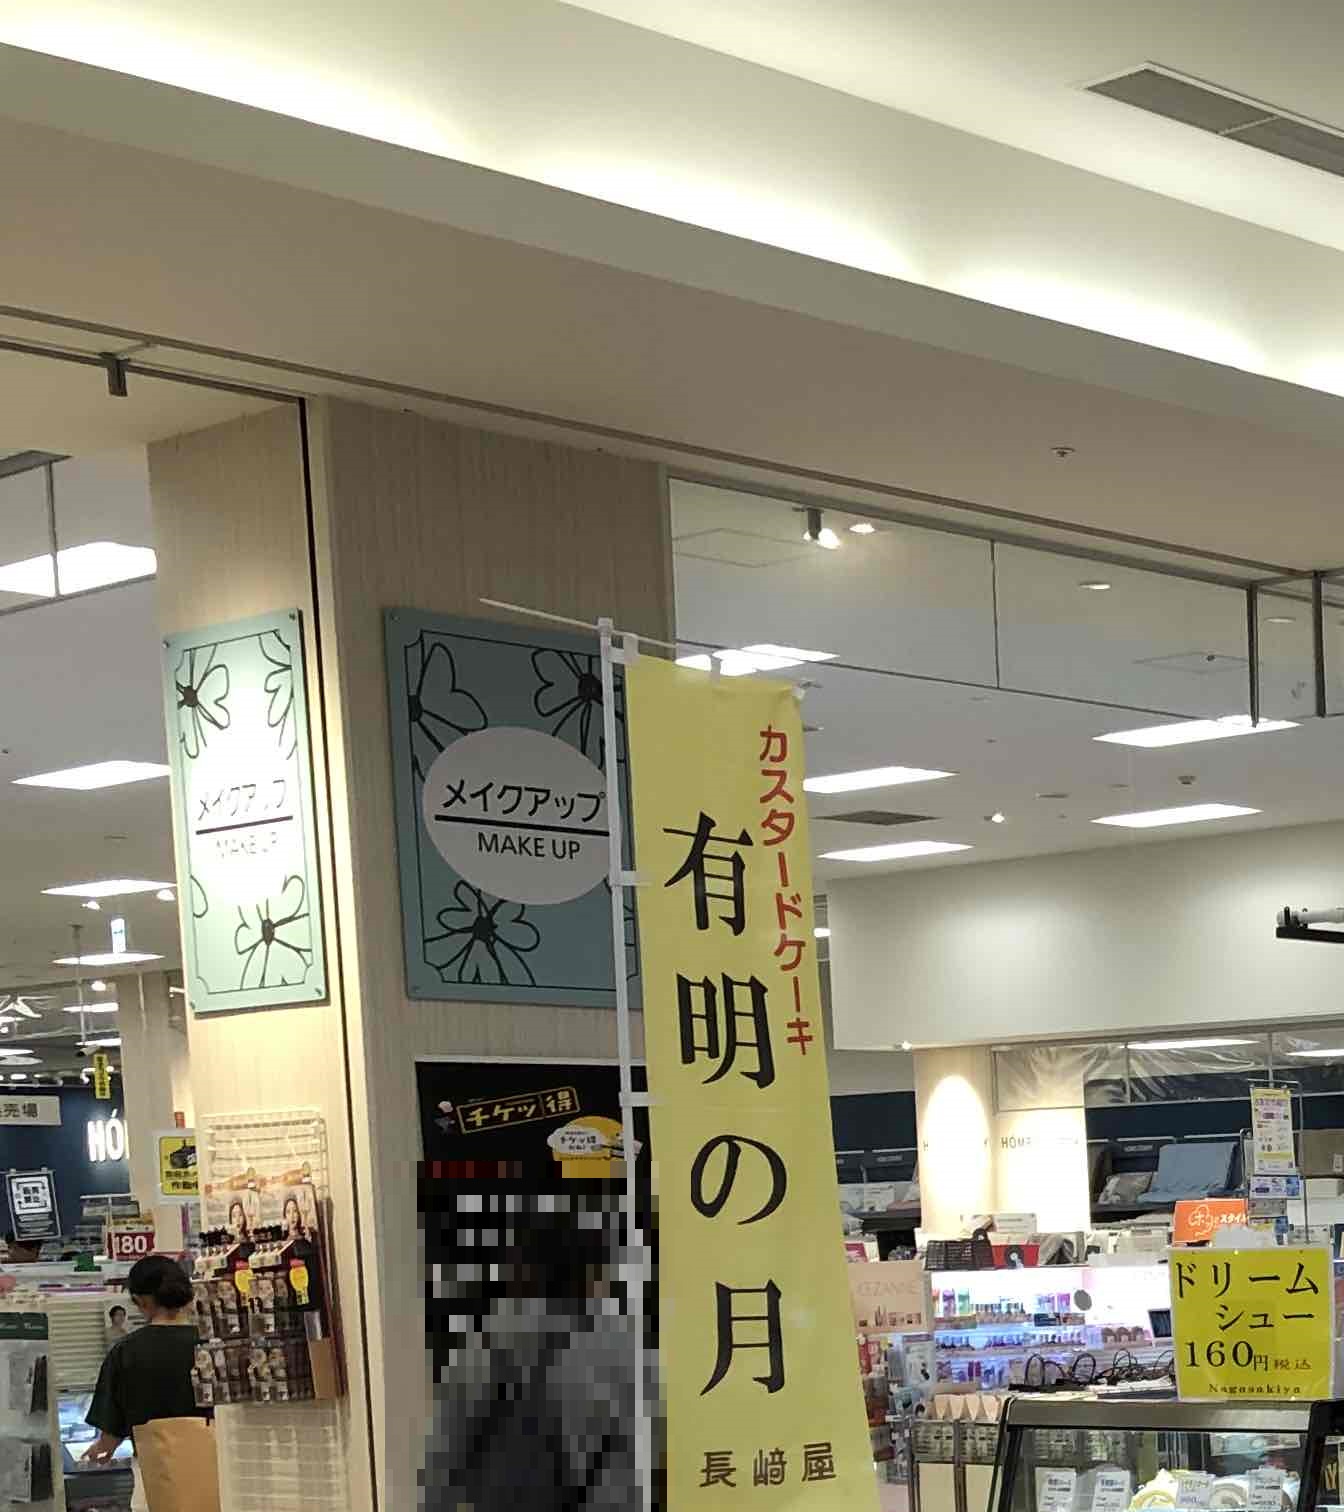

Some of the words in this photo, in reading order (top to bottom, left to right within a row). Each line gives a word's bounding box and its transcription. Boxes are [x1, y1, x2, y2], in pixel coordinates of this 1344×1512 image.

[442, 779, 607, 824] メイクアップ
[477, 832, 546, 859] MAKE
[551, 837, 581, 860] UP
[759, 724, 813, 1056] カスタードケーキ
[0, 1102, 39, 1118] 売場
[465, 1090, 573, 1127] チケッ得
[662, 810, 787, 1398] 有明の月
[1176, 1262, 1319, 1299] ドリーム
[1215, 1303, 1315, 1332] シュー
